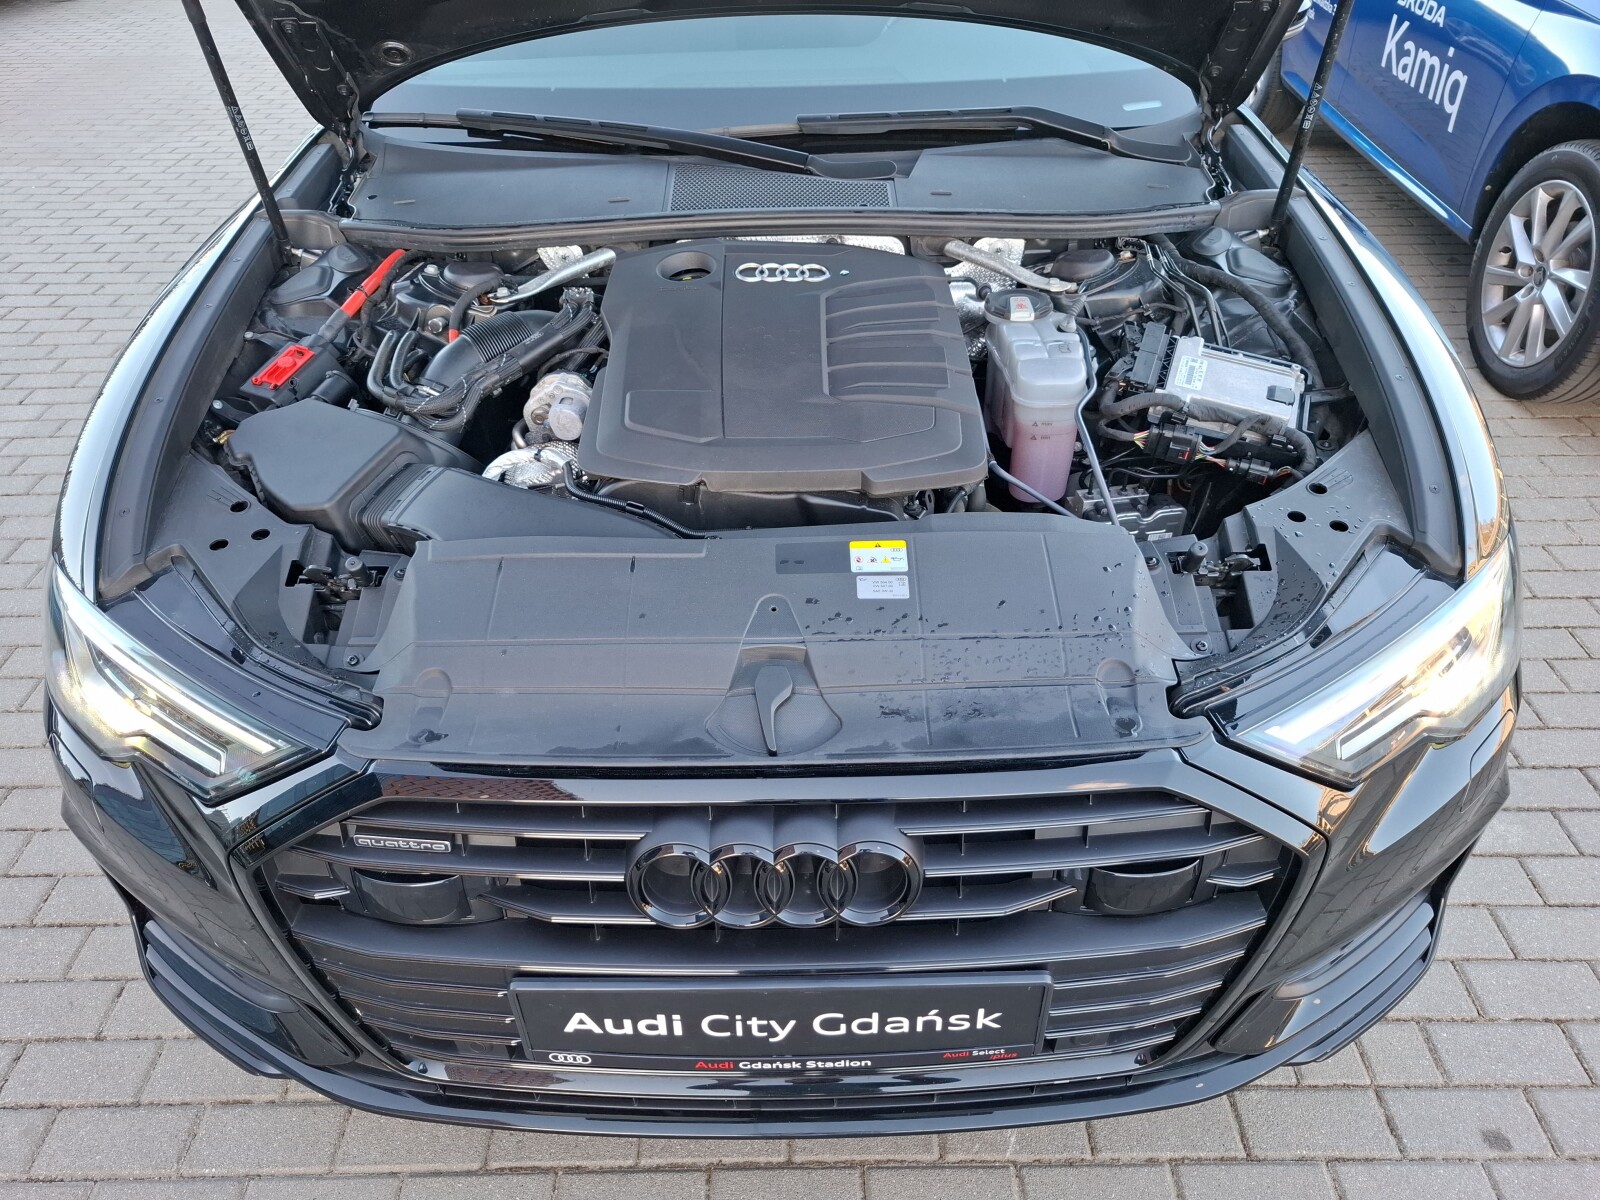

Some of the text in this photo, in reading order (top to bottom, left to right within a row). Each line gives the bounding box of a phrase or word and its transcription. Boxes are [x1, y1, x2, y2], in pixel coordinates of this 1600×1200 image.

[1380, 13, 1468, 133] Kamiq
[358, 838, 446, 851] quattro
[563, 1007, 1003, 1043] Audi City Gdańsk
[971, 1048, 1006, 1056] Select
[695, 1059, 872, 1070] Audi Gdańsk Stadion
